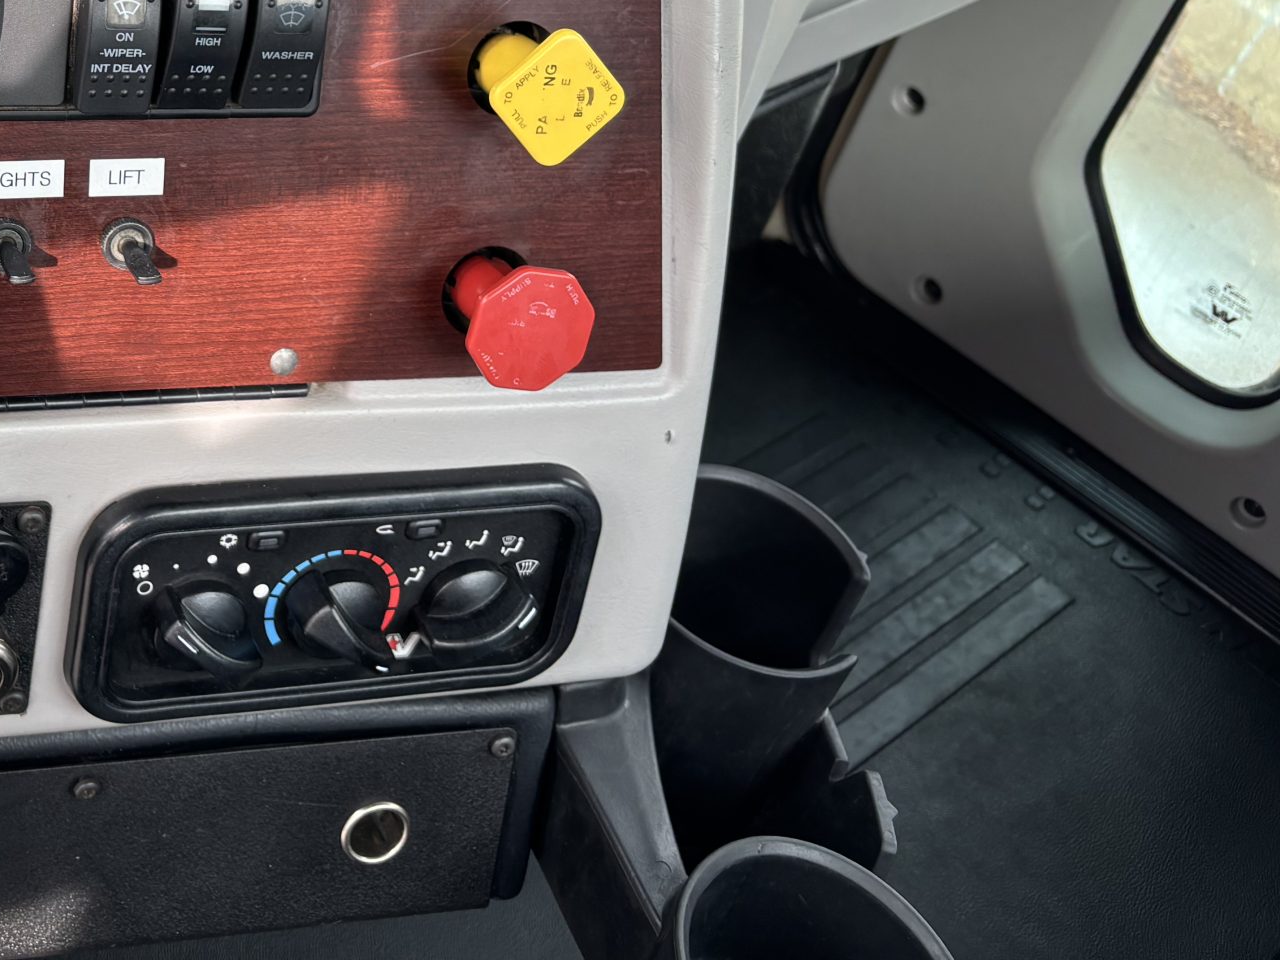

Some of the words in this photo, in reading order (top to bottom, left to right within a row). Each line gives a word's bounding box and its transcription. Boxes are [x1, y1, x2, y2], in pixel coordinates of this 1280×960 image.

[115, 32, 135, 42] ON
[195, 37, 222, 48] HIGH
[261, 50, 314, 61] WASHER
[90, 63, 111, 74] INT
[112, 63, 152, 75] DELAY
[189, 64, 214, 75] LOW
[504, 91, 514, 105] TO
[515, 65, 540, 90] APPLY
[585, 110, 609, 132] PUSH
[608, 93, 618, 107] TO
[108, 169, 145, 185] LIFT
